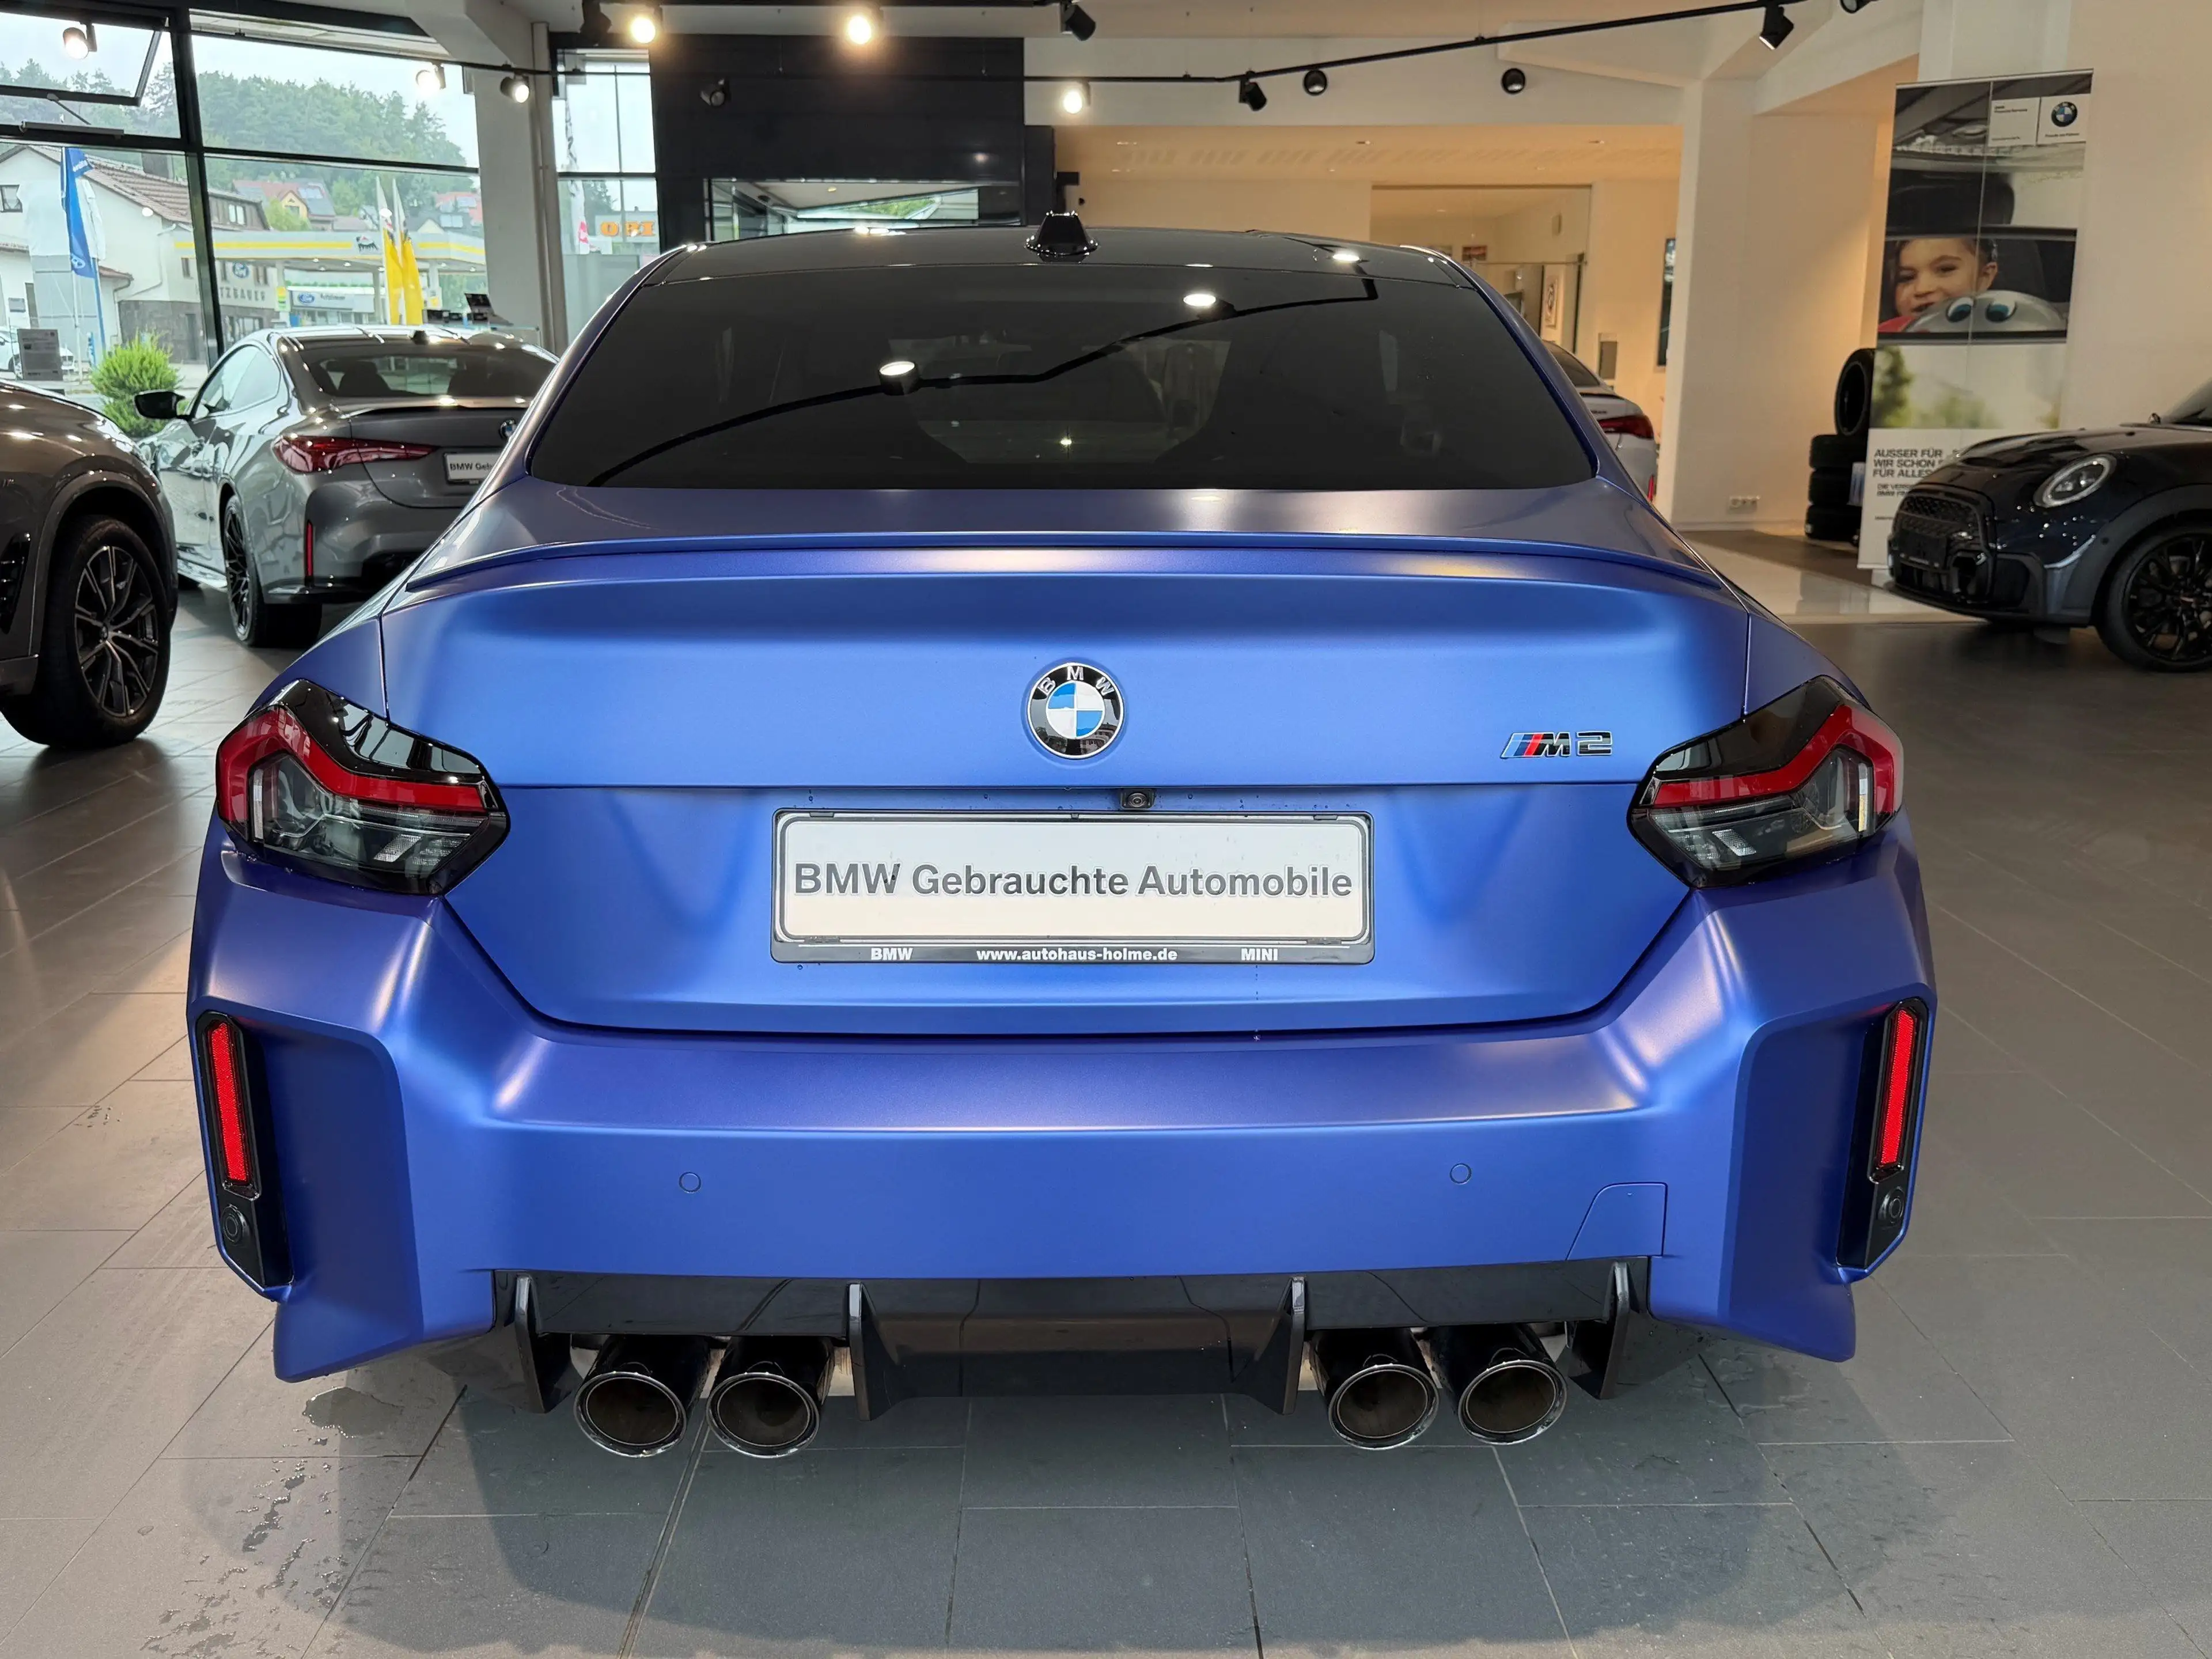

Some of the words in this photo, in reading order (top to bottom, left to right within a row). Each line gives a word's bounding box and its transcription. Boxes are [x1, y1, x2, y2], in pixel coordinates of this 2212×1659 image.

[1874, 449, 1918, 458] AUSSER
[1921, 447, 1942, 458] FÜR
[450, 462, 473, 471] BMW
[1873, 459, 1894, 468] WIR
[1037, 666, 1116, 696] BMW
[795, 862, 900, 894] BMW
[912, 863, 1129, 895] Gebrauchte
[1138, 865, 1353, 896] Automobile
[870, 948, 913, 961] BMW
[976, 948, 1178, 961] www.autohaus-holme.de
[1241, 948, 1278, 961] MINI
